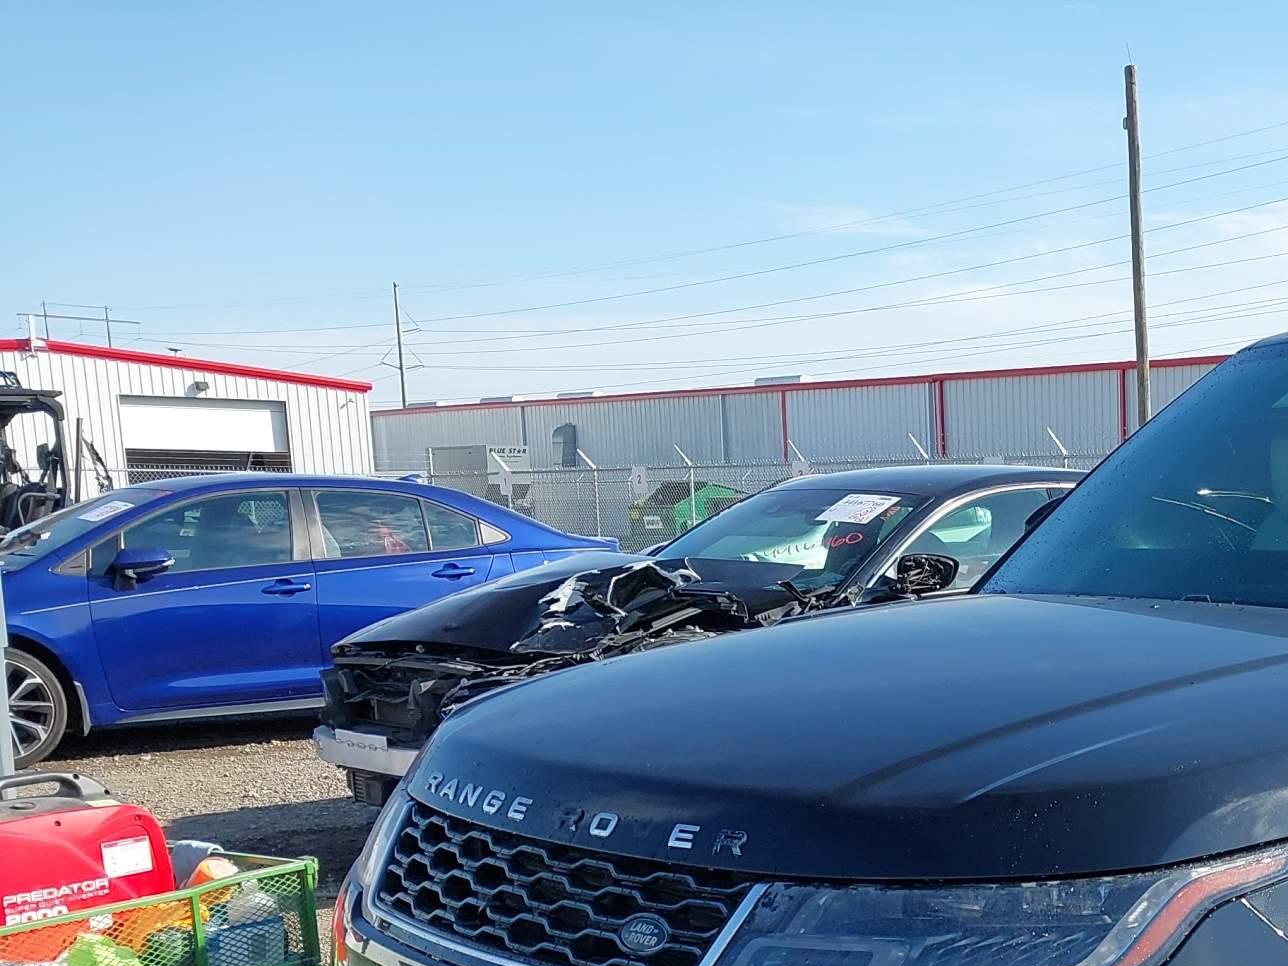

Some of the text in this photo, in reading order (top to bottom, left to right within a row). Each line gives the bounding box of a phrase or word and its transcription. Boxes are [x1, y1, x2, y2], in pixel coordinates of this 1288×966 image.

[424, 772, 534, 822] RANGE
[2, 877, 110, 908] PREDATOR
[628, 932, 658, 947] ROVER
[629, 921, 655, 935] LAND
